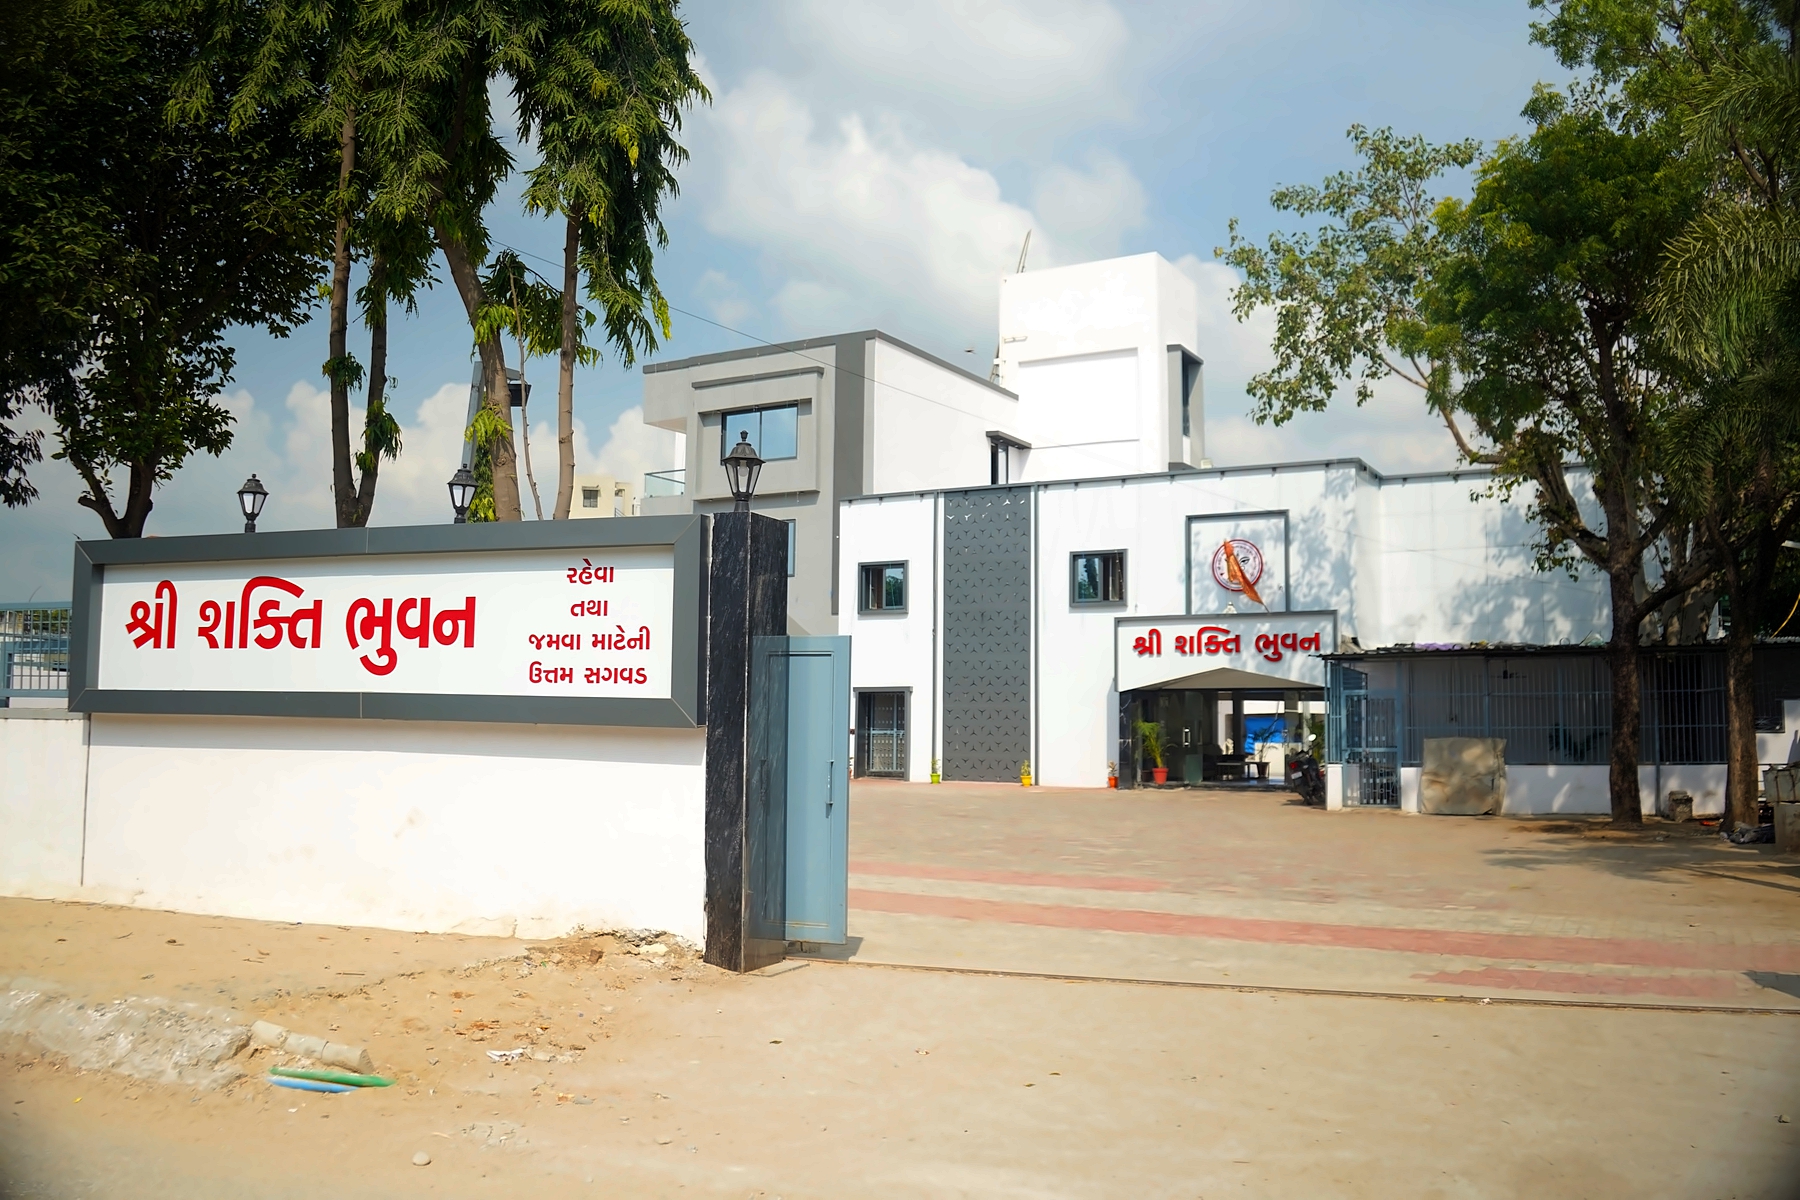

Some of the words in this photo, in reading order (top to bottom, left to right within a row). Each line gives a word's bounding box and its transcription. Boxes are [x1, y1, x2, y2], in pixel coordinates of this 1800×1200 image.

[566, 558, 615, 585] રહેવા
[570, 599, 609, 617] તથા
[125, 579, 178, 649] શ્રી
[197, 575, 323, 650] શક્તિ
[345, 596, 477, 676] ભુવન
[528, 633, 581, 651] જમવા
[591, 625, 651, 651] માટેની
[1132, 628, 1162, 656] શ્રી
[1174, 626, 1241, 655] શક્તિ
[1254, 632, 1321, 663] ભુવન
[528, 660, 574, 684] ઉત્તમ
[584, 667, 648, 685] સગવડ
